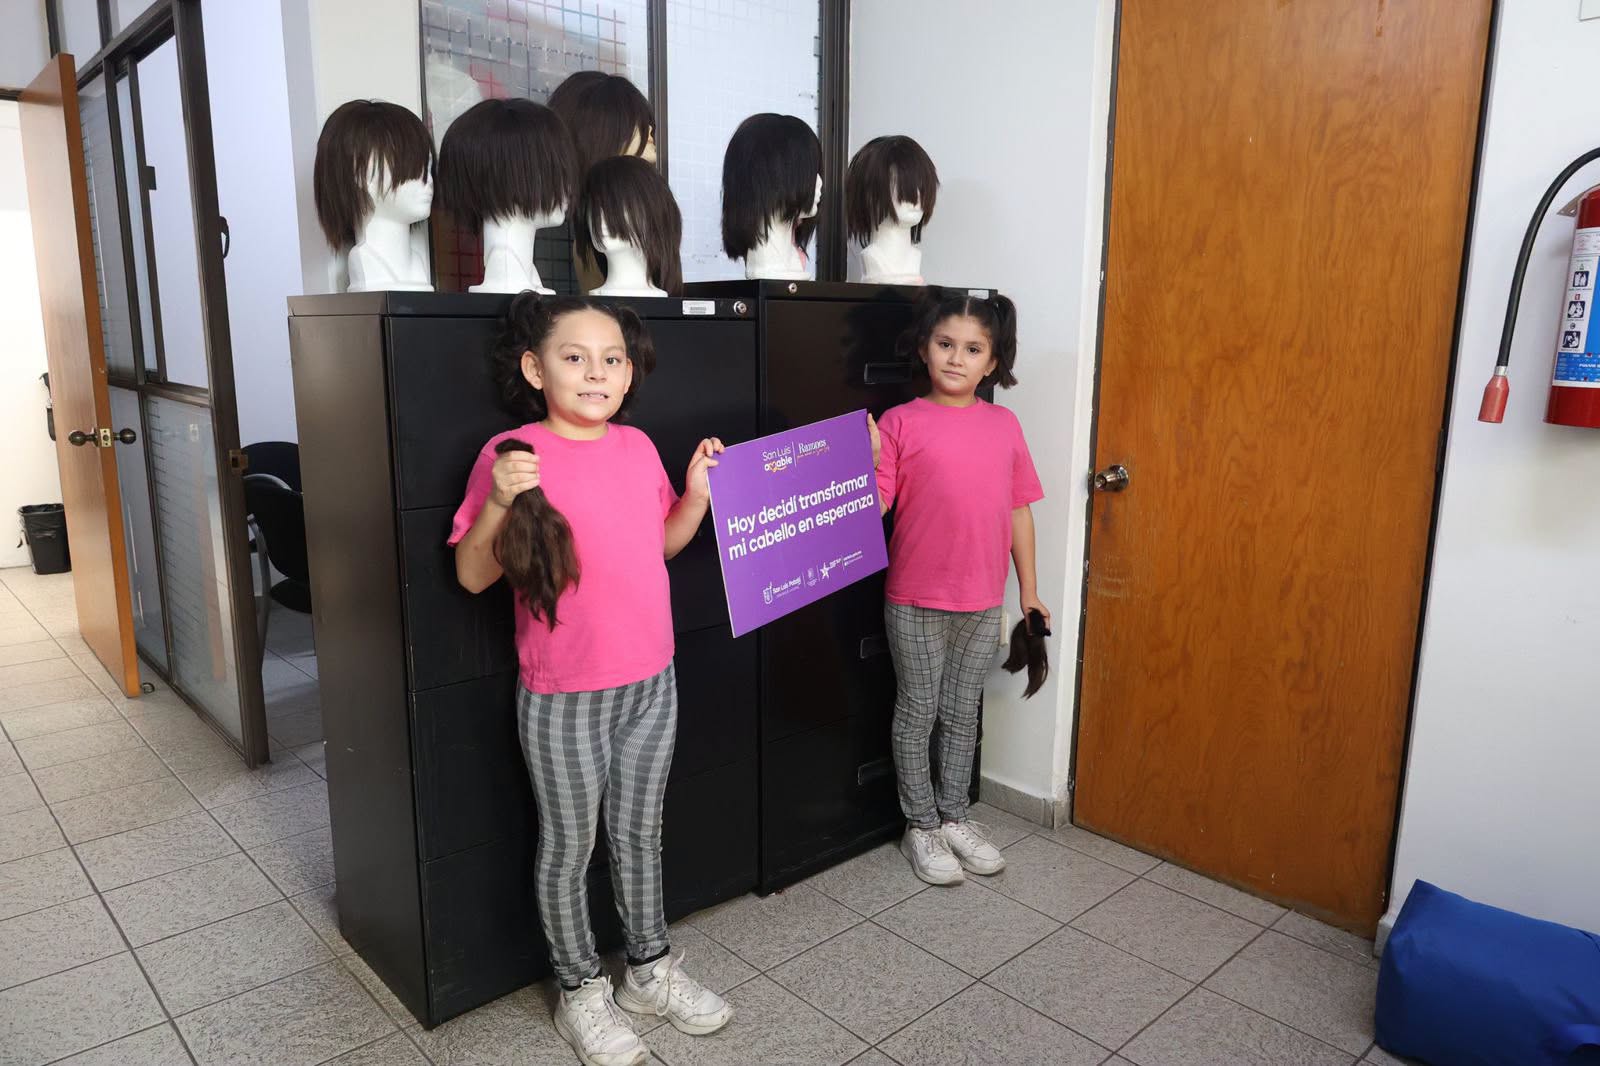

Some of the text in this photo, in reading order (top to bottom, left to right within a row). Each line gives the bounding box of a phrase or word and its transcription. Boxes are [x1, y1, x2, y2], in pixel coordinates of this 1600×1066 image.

[762, 450, 777, 462] San
[777, 445, 792, 457] Luis
[727, 473, 869, 536] Hoy decidí transformar
[728, 493, 875, 561] mi cabello en esperanza
